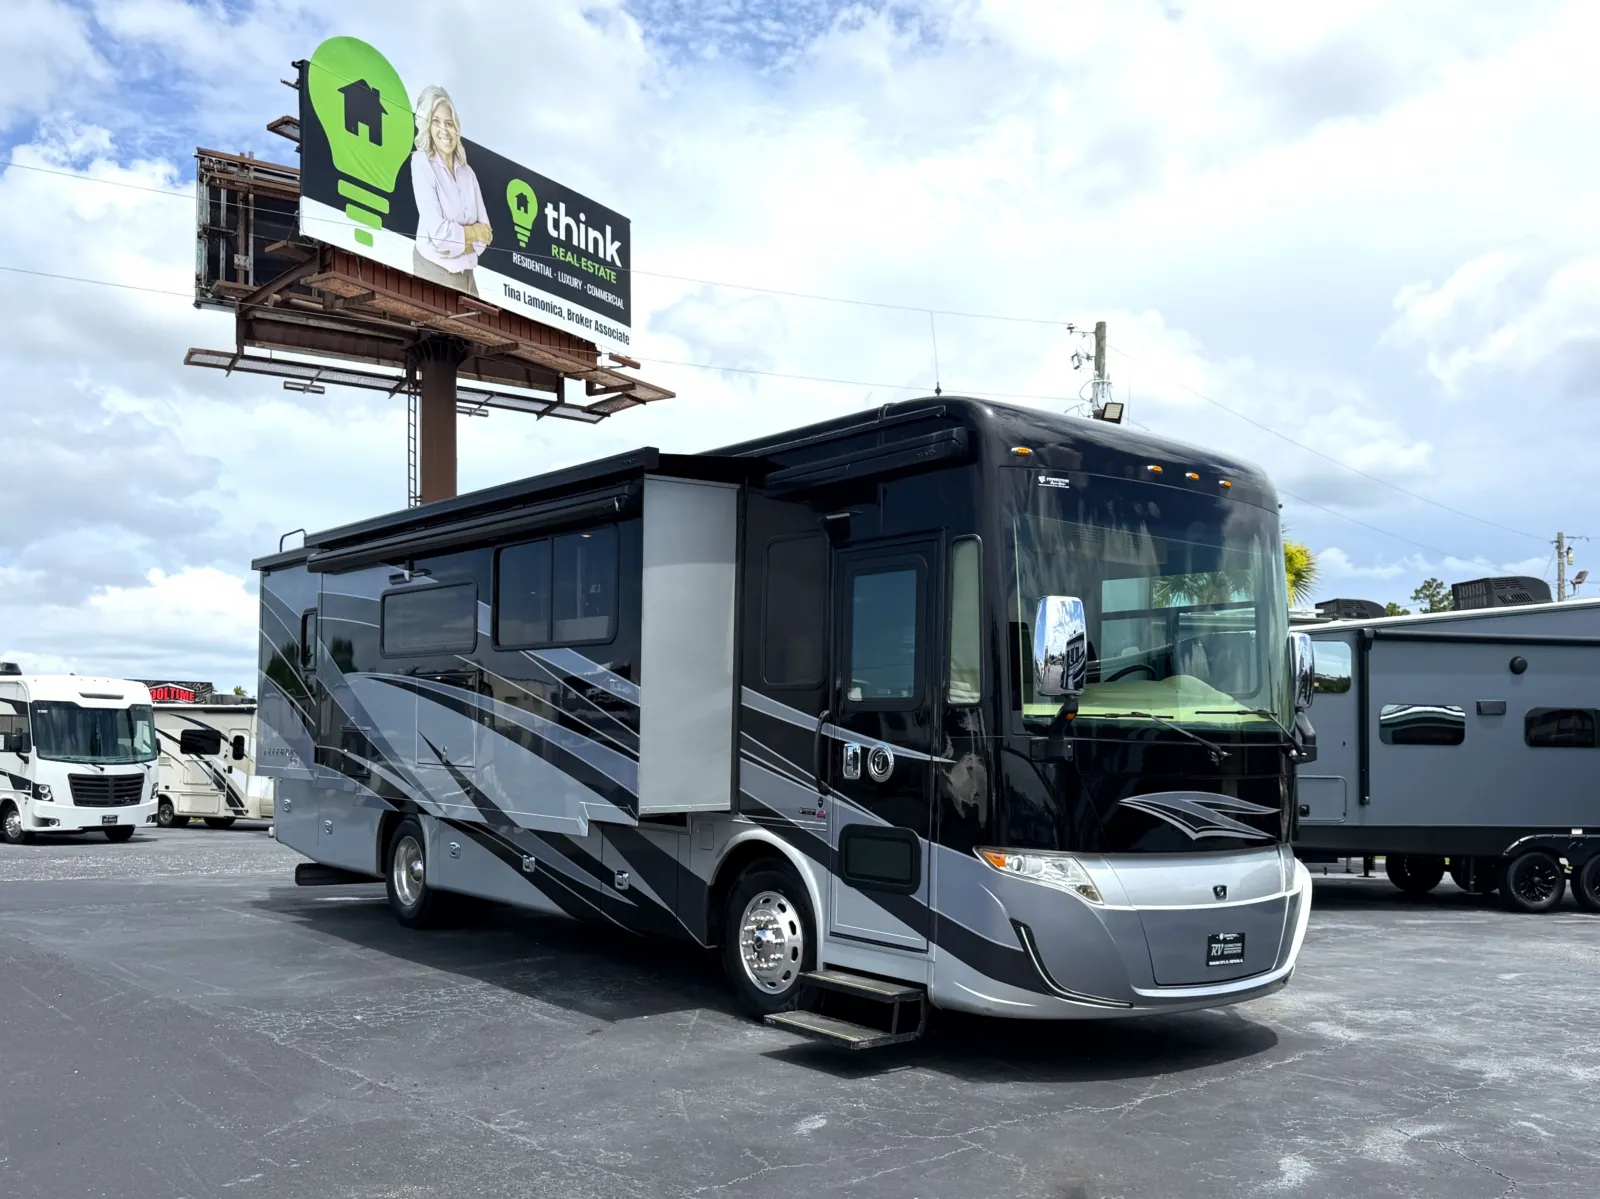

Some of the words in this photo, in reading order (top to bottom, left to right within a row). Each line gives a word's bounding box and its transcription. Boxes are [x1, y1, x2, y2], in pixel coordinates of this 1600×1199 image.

[544, 201, 622, 268] think
[512, 252, 553, 279] RESIDENTIAL
[558, 271, 583, 290] LUXURY
[586, 283, 625, 310] COMMERCIAL
[551, 243, 580, 267] REAL
[581, 257, 617, 284] ESTATE
[503, 283, 521, 302] Tina
[523, 291, 565, 320] Lamonica,
[567, 308, 592, 330] Broker
[594, 320, 630, 346] Associate
[150, 687, 169, 700] OOL
[169, 687, 195, 702] TIME
[1211, 943, 1223, 956] RV
